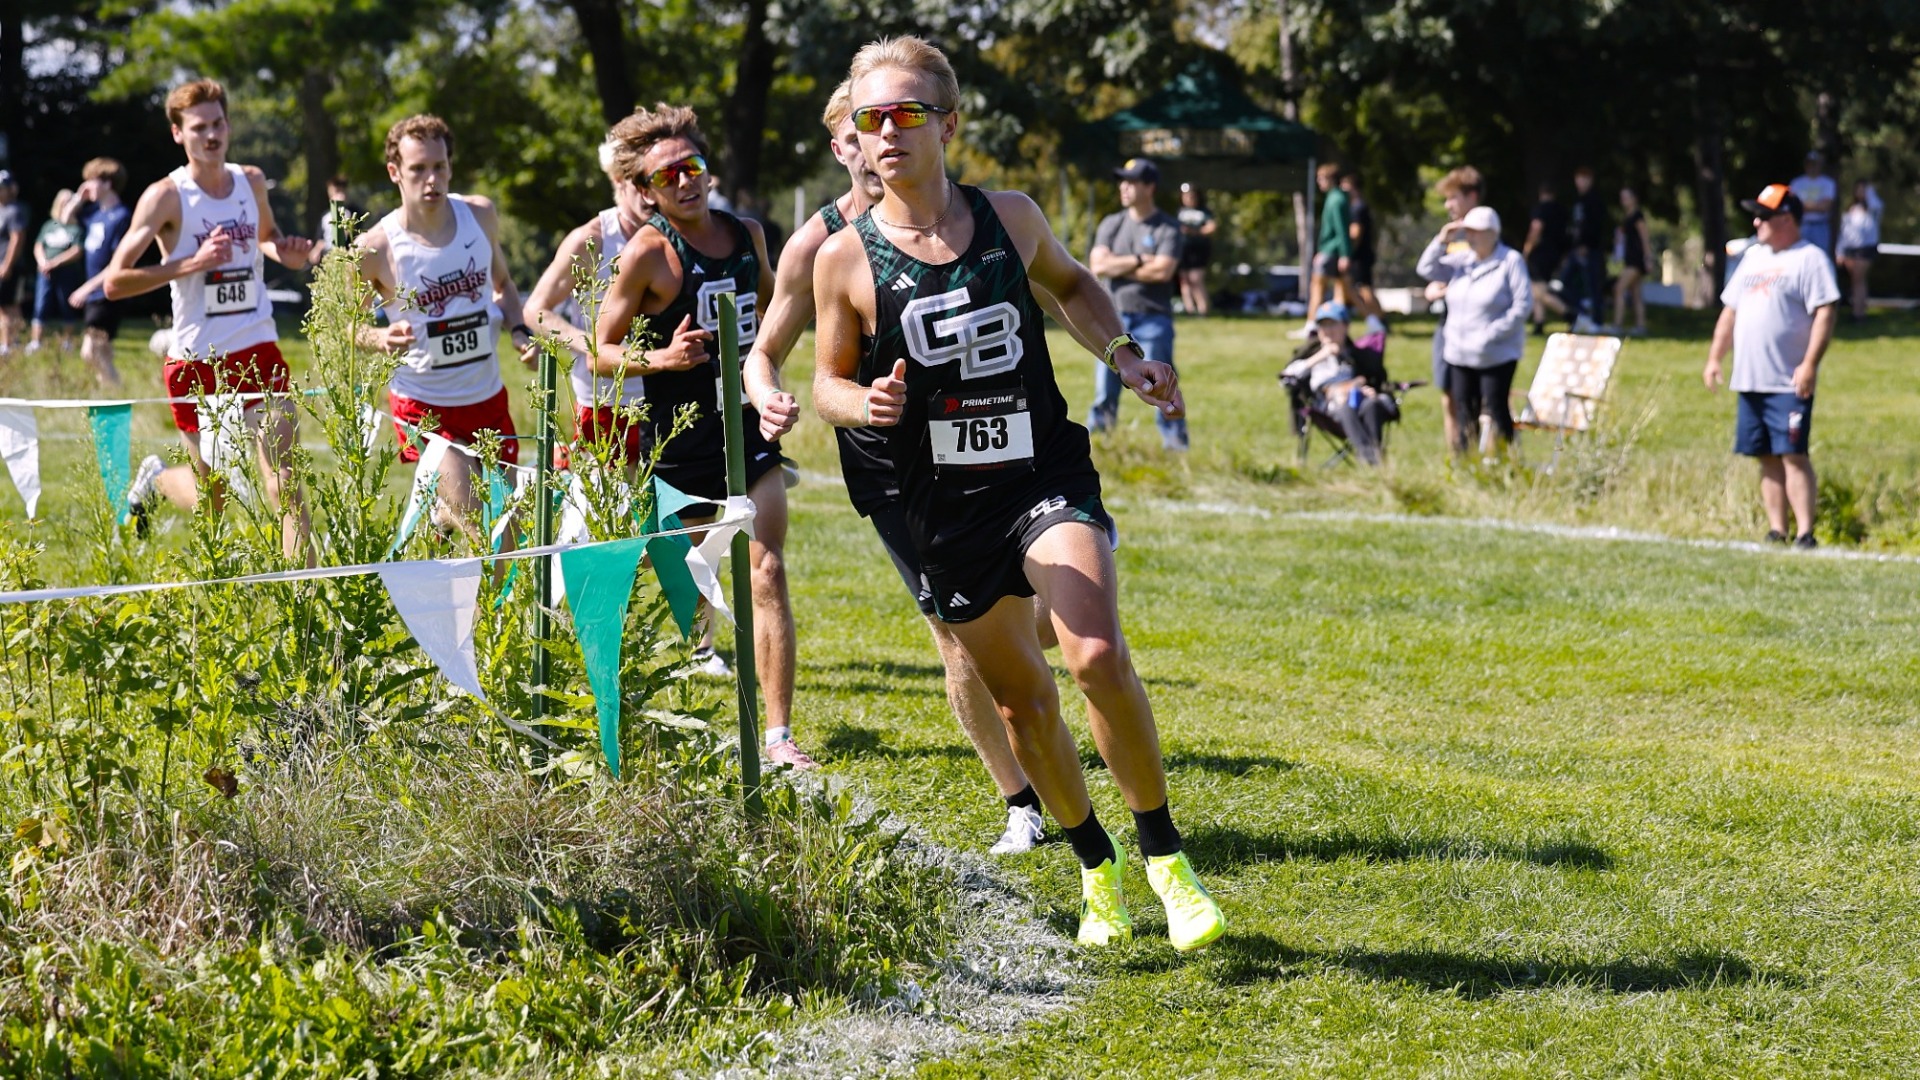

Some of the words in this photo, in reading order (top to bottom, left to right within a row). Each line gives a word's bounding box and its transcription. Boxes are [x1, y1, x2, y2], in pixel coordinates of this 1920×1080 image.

[217, 283, 246, 304] 648
[416, 268, 487, 306] RAIDERS
[442, 330, 479, 356] 639
[900, 287, 1024, 380] GB
[961, 394, 1015, 408] PRIMETIME
[952, 417, 1009, 453] 763
